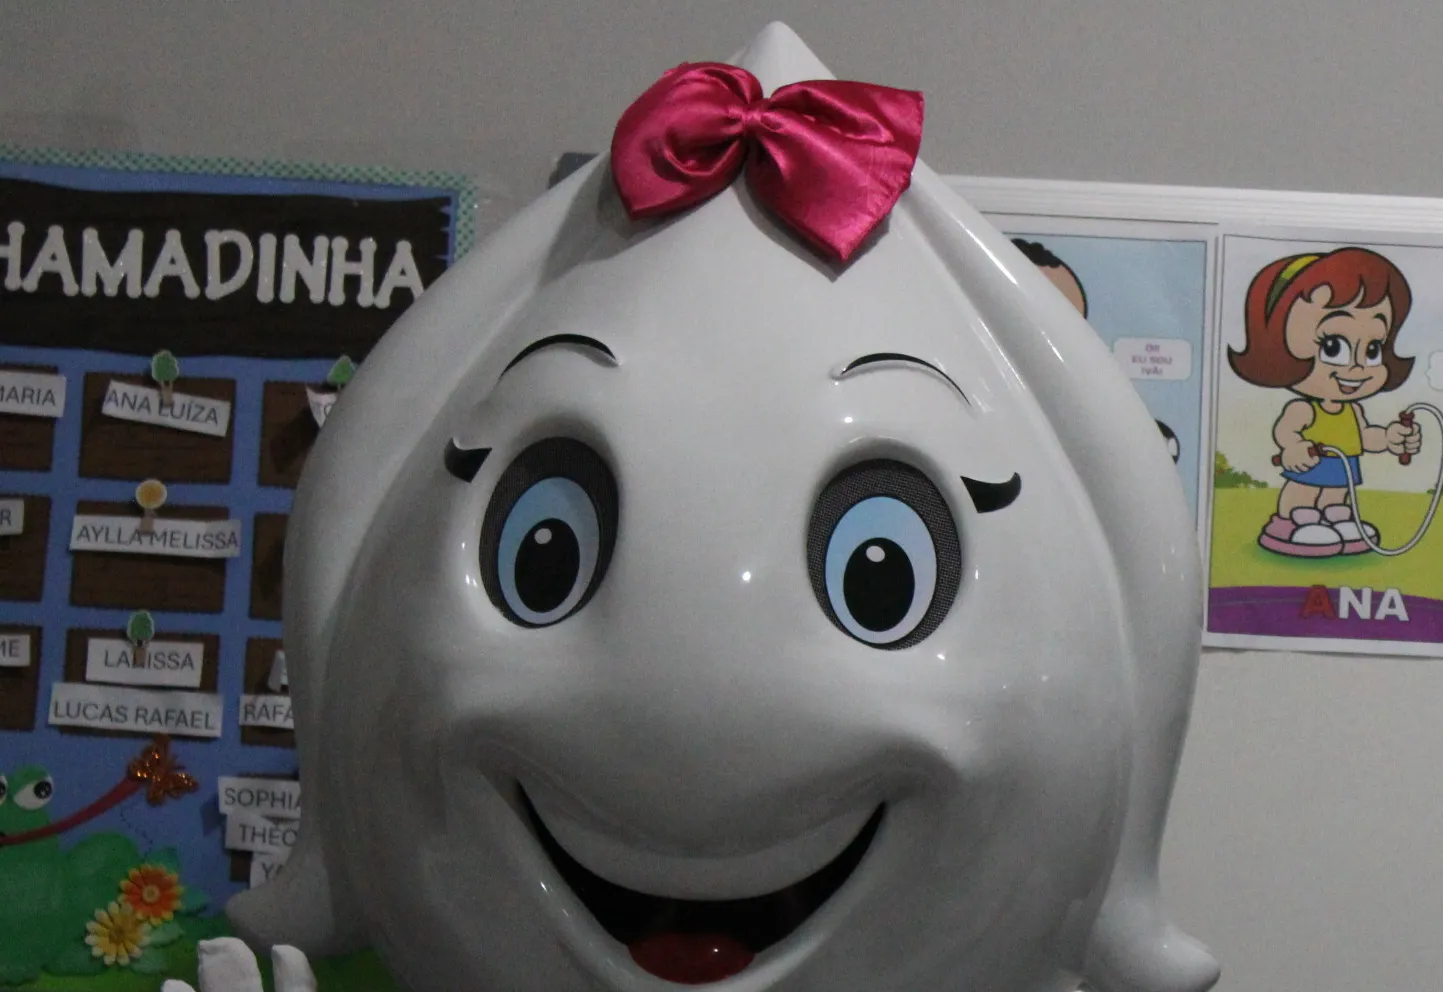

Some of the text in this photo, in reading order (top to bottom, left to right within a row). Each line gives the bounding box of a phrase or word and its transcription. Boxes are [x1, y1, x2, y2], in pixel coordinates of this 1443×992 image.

[0, 385, 56, 407] ARIA
[105, 387, 152, 415] ANA
[150, 529, 239, 551] MELISSA
[1298, 584, 1410, 622] ANA
[104, 649, 195, 671] LAISSA
[53, 700, 216, 731] LUCAS RAFAEL
